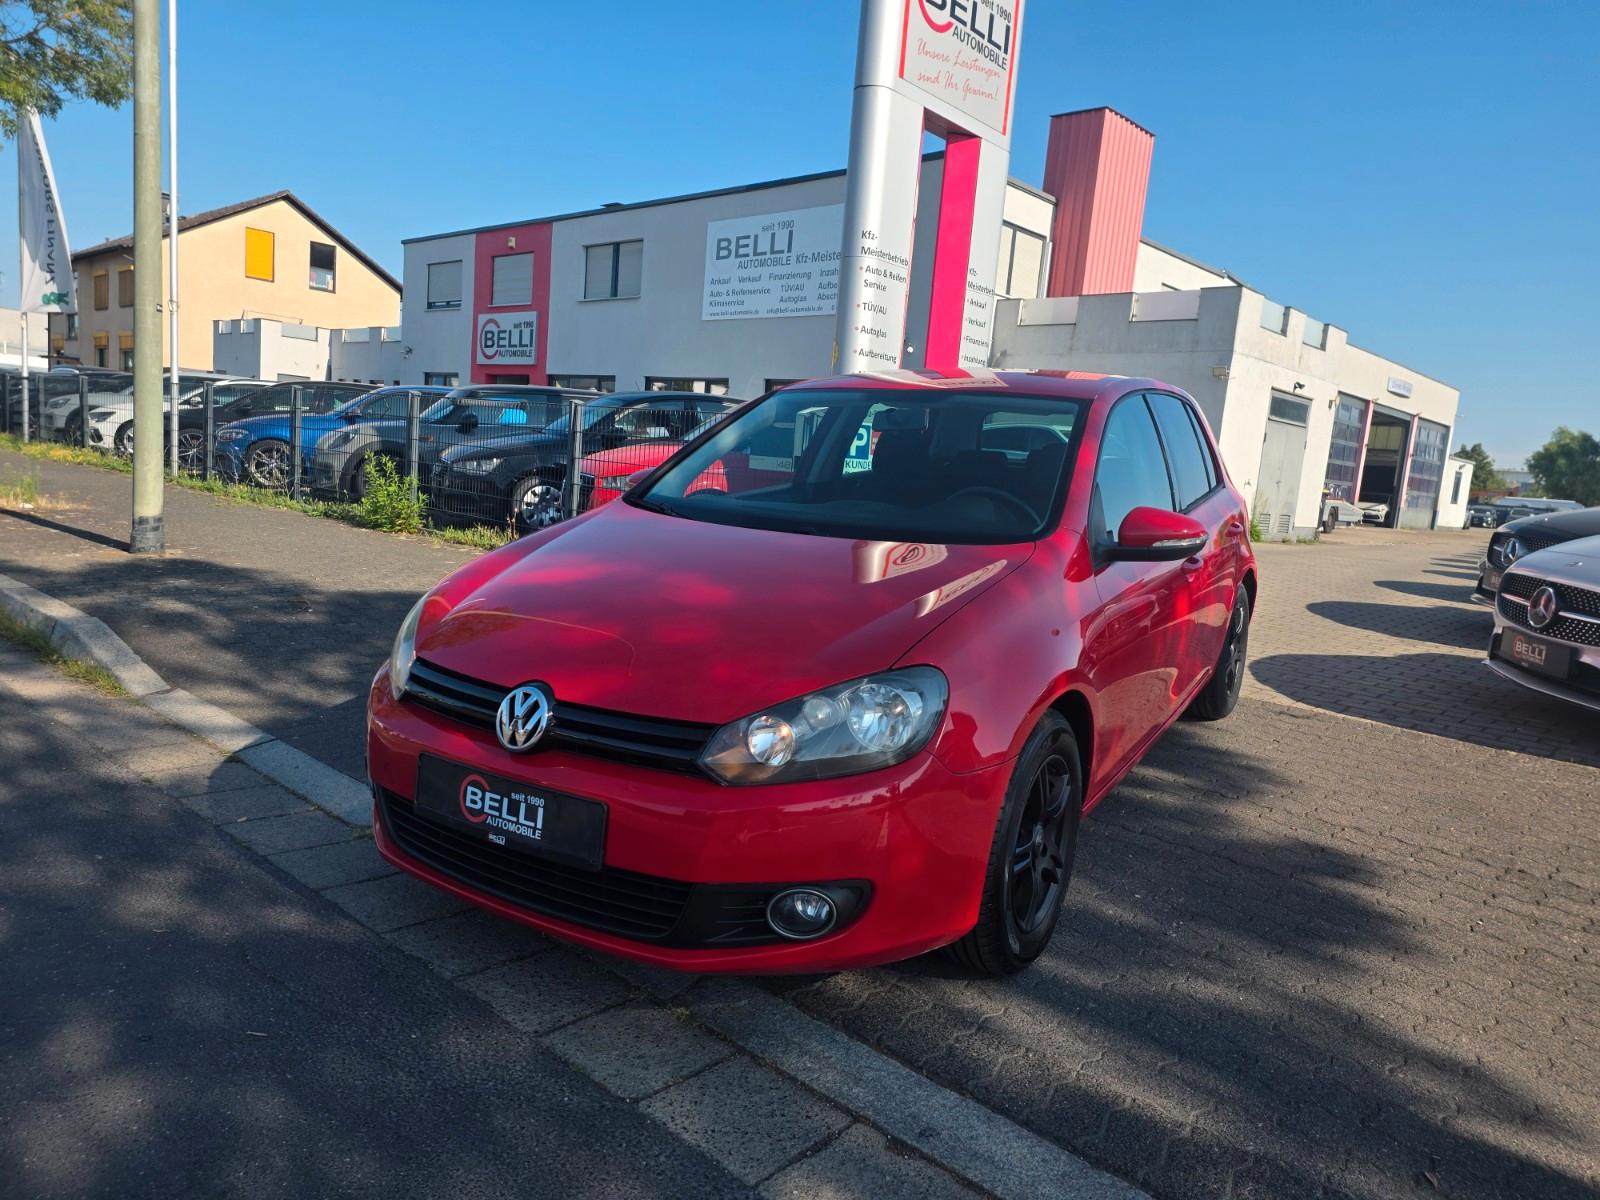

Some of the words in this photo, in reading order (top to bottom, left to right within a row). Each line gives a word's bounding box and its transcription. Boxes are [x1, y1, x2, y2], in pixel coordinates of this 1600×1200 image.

[996, 4, 1011, 23] 1990
[926, 0, 1011, 55] ELLI
[917, 37, 951, 63] Unsere
[952, 25, 1008, 70] AUTOMOBILE
[761, 222, 776, 232] seit
[777, 219, 795, 230] 1990
[861, 229, 878, 240] Kfz-
[716, 229, 794, 261] BELLI
[737, 255, 792, 270] AUTOMOBILE
[860, 245, 909, 267] Meisterbetrieb
[710, 276, 731, 286] Ankauf
[738, 273, 762, 284] Verkauf
[768, 271, 812, 281] Finanzierung
[865, 264, 882, 276] Auto
[883, 268, 888, 279] &
[888, 271, 907, 284] Reifen
[731, 287, 771, 297] Reifenservice
[863, 278, 887, 292] Service
[709, 299, 745, 308] Klimaservice
[862, 301, 888, 315] TÜV/AU
[859, 325, 888, 339] Autoglas
[968, 318, 986, 329] Verkauf
[483, 328, 534, 349] BELLI
[497, 349, 533, 358] AUTOMOBILE
[858, 347, 898, 365] Aufbereitung
[850, 427, 868, 456] P
[1515, 640, 1546, 661] BELLI
[465, 785, 544, 830] BELLI
[511, 792, 525, 802] seit
[526, 794, 545, 808] 1990
[485, 815, 542, 840] AUTOMOBILE
